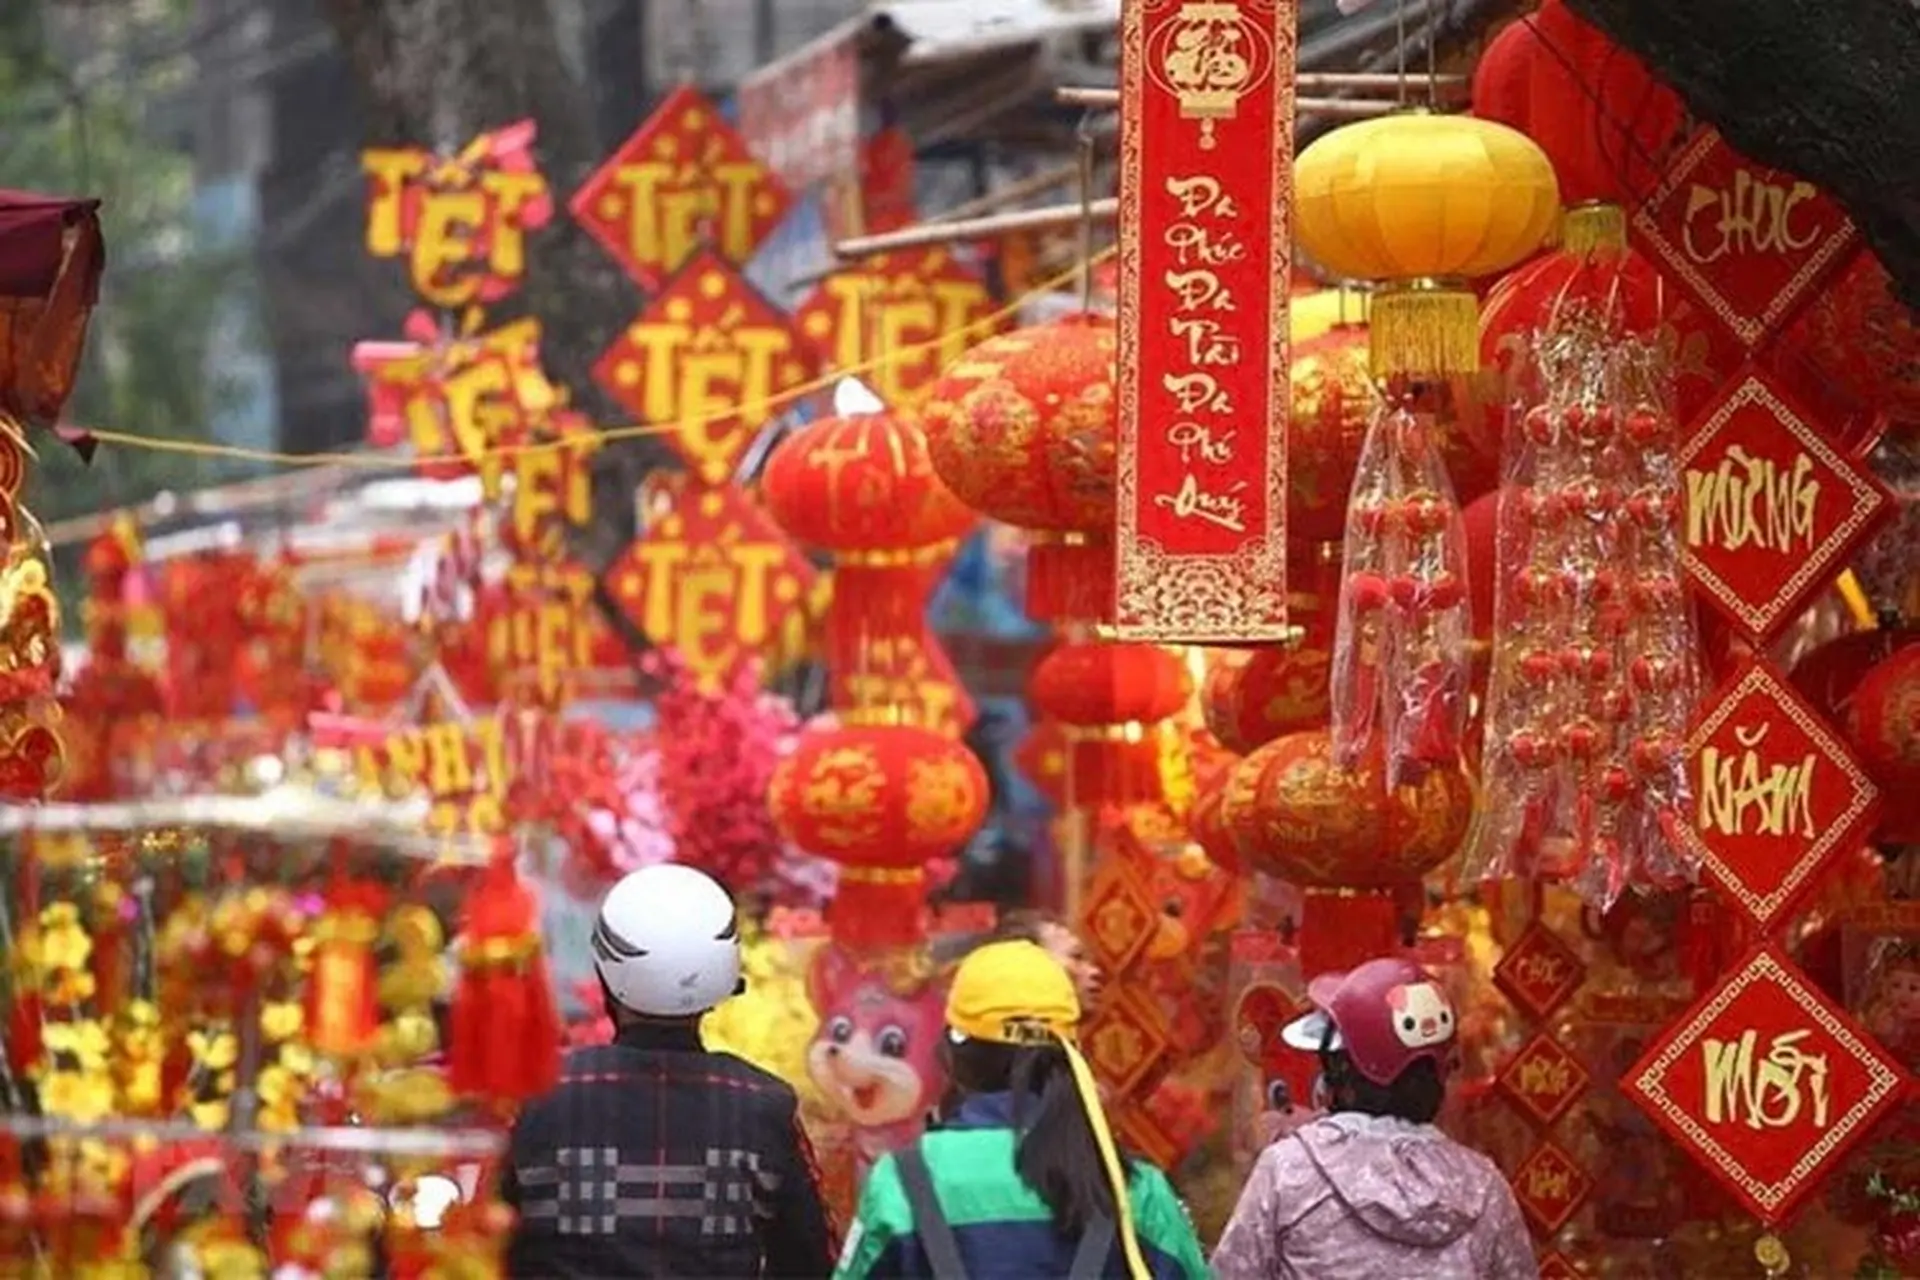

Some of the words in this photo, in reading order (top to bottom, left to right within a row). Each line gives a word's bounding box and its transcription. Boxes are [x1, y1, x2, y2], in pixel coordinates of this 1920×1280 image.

[1164, 223, 1247, 265] Phúc
[627, 301, 790, 460] TẾT
[1169, 317, 1240, 365] Tài
[1167, 422, 1237, 464] Phú
[1154, 474, 1248, 532] Quý
[1686, 444, 1820, 554] MỪNG
[636, 521, 786, 674] TẾT
[1700, 721, 1816, 839] NĂM
[1701, 1029, 1829, 1129] MỚI
